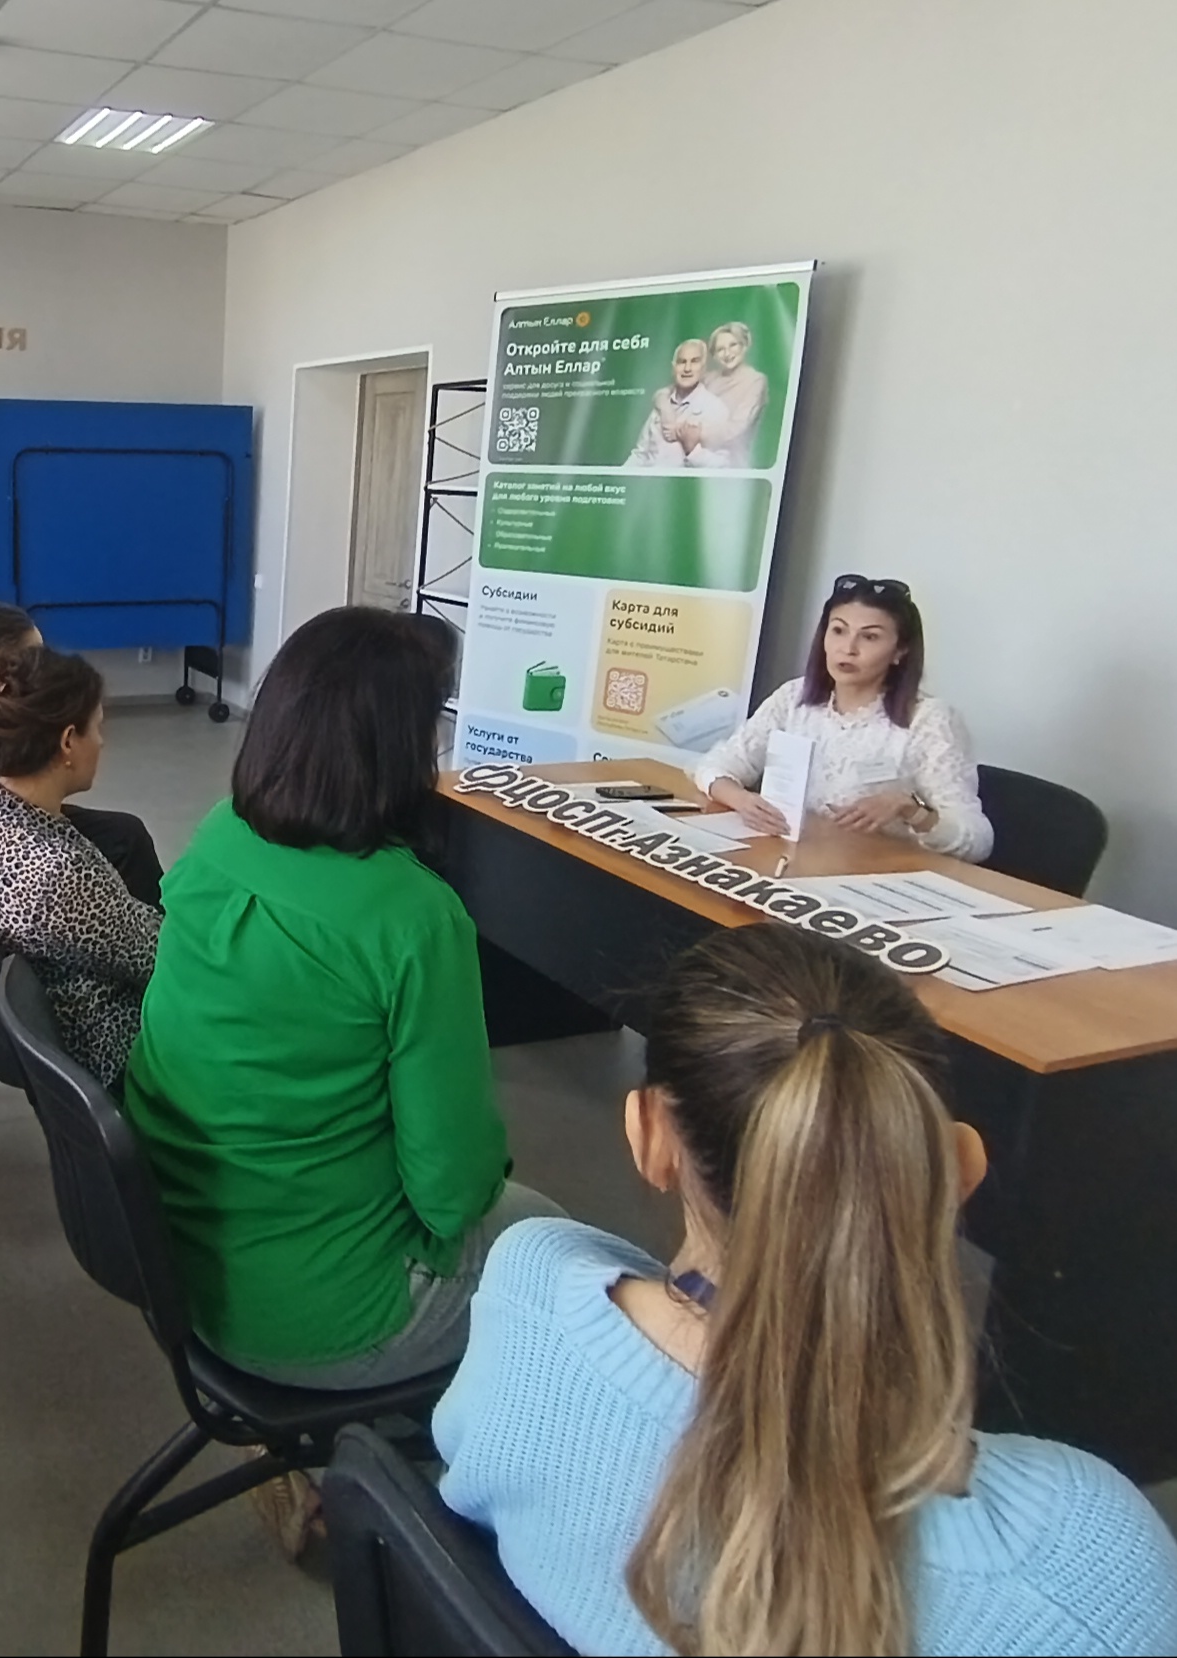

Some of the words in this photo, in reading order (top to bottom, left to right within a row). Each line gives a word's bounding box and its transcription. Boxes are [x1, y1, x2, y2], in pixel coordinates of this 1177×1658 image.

[508, 318, 542, 329] Алтын
[543, 316, 573, 327] Еллар
[506, 340, 576, 357] Откройте
[578, 340, 609, 354] для
[612, 334, 650, 350] себя
[504, 362, 552, 376] Алтын
[493, 481, 526, 490] Каталог
[574, 482, 603, 492] любой
[604, 485, 626, 494] вкус
[491, 492, 508, 500] для
[508, 493, 539, 501] любого
[482, 585, 537, 601] Субсидии
[612, 599, 650, 614] Карта
[653, 606, 679, 617] для
[609, 618, 675, 634] субсидий
[467, 725, 504, 742] Услуги
[507, 736, 520, 745] от
[465, 741, 533, 764] государства
